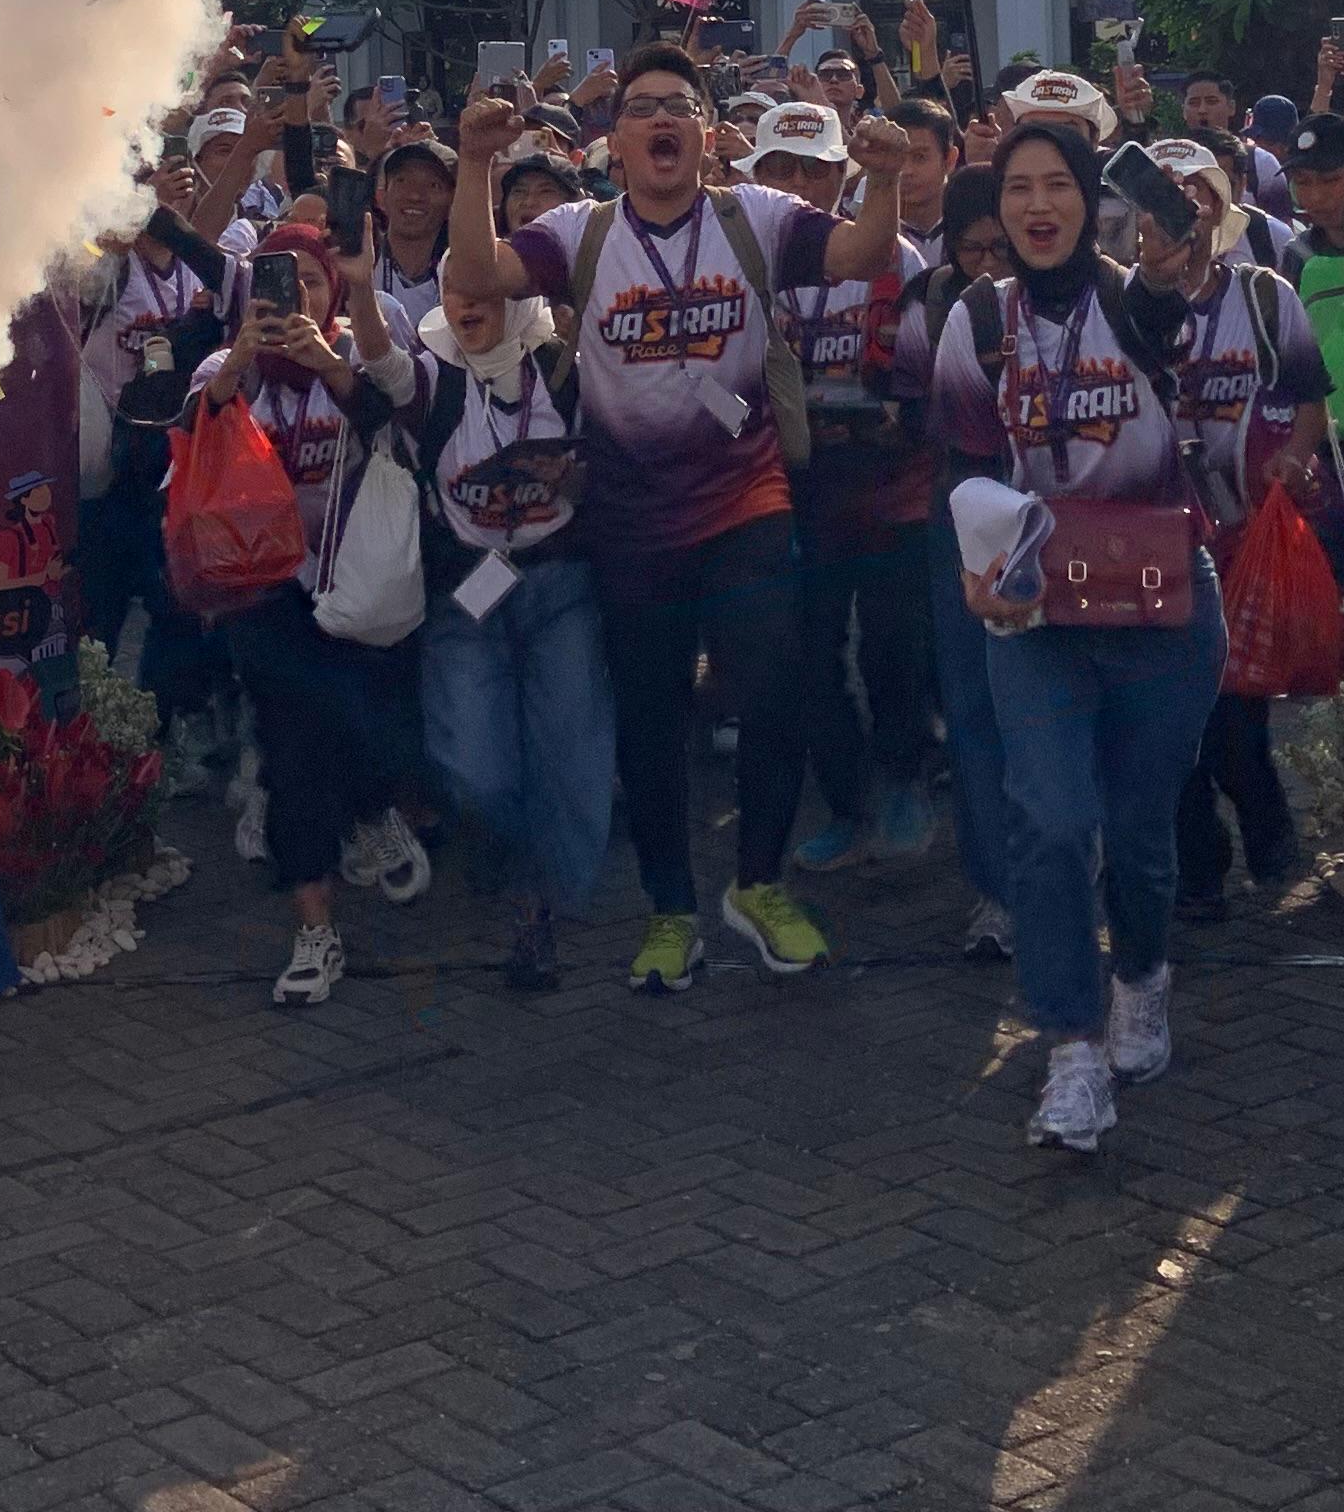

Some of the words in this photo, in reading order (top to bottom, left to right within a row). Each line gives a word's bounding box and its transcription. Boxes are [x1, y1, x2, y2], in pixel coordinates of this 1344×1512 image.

[774, 120, 825, 134] JASIRAH
[604, 299, 742, 342] JASIRAH
[628, 343, 680, 359] Race
